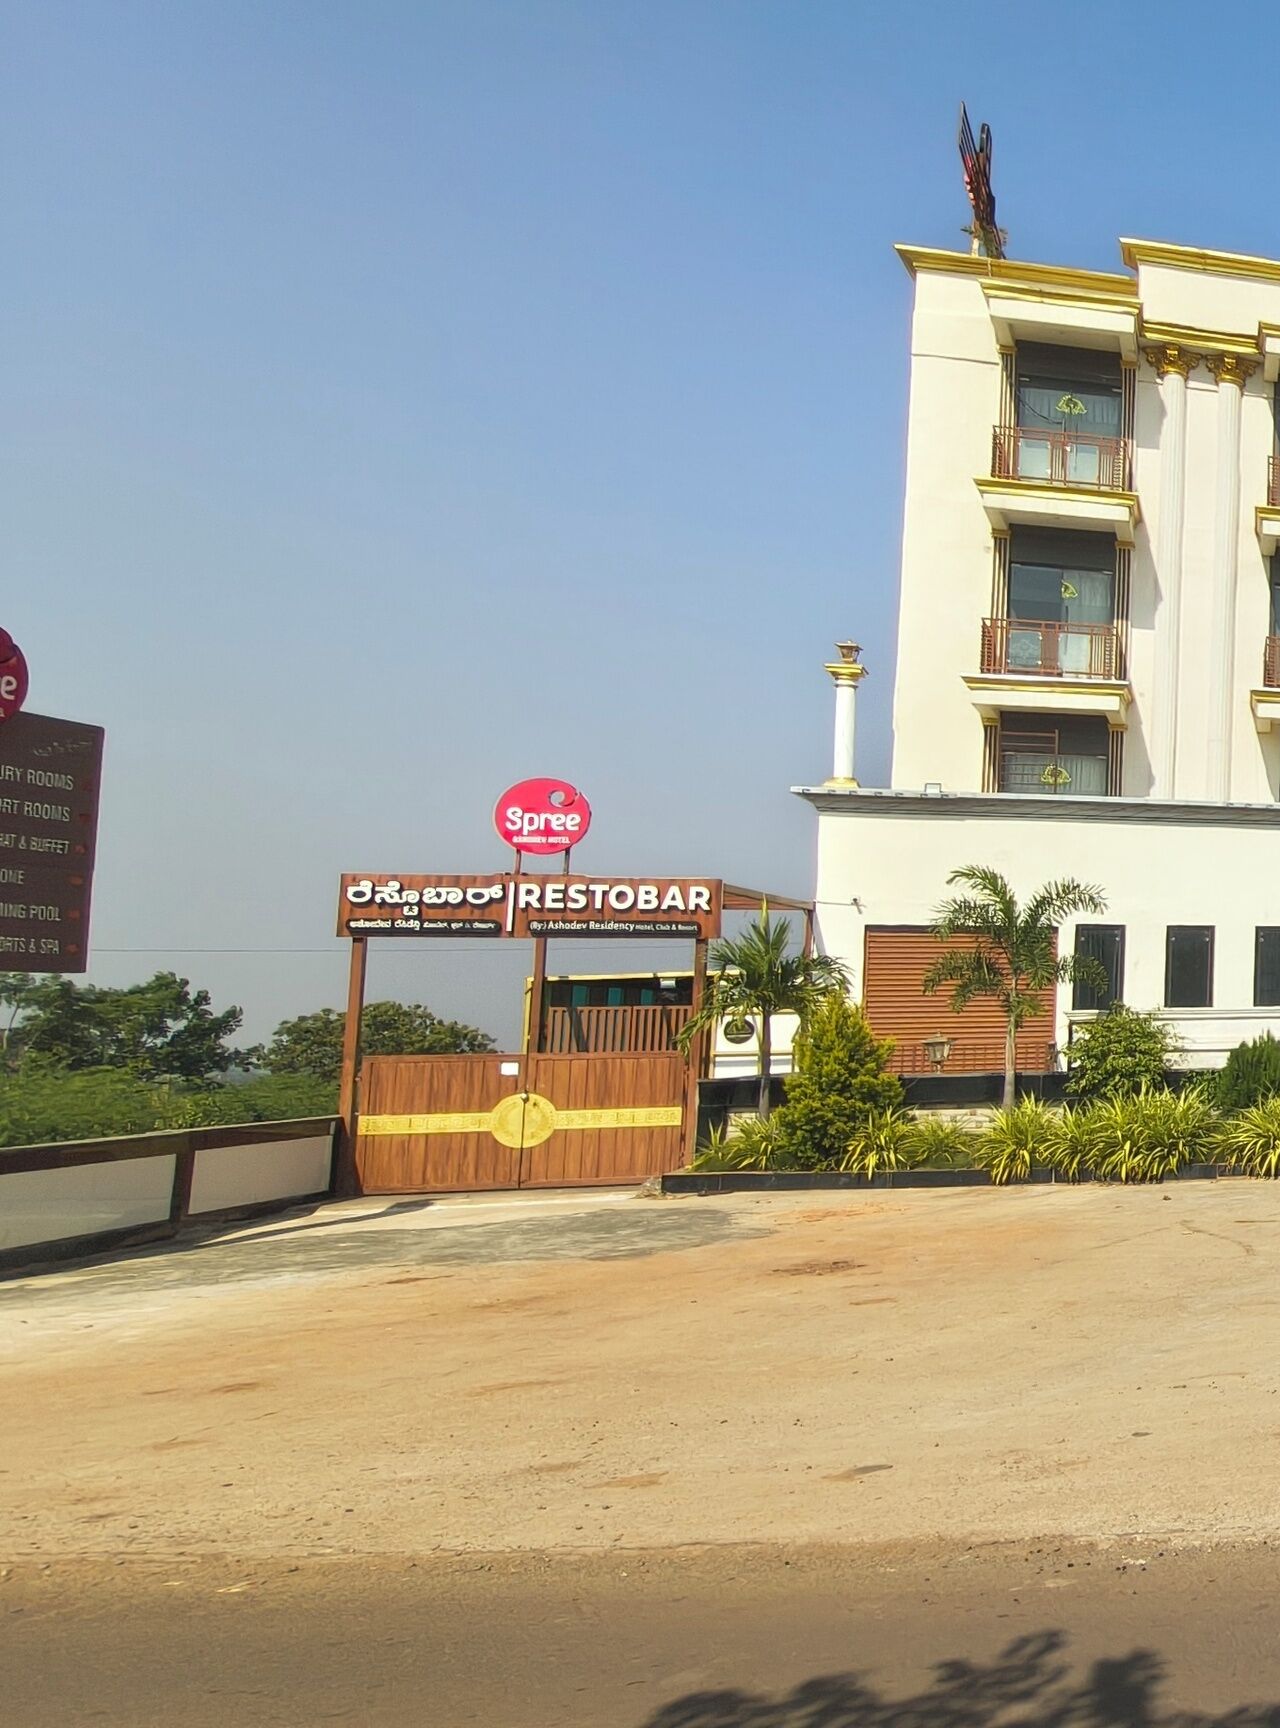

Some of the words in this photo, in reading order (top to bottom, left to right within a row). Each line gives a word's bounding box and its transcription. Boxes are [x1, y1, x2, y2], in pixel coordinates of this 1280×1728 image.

[27, 769, 74, 790] ROOMS
[24, 801, 71, 821] ROOMS
[505, 806, 582, 836] Spree
[19, 836, 27, 849] &
[30, 836, 70, 855] BUFFET
[518, 883, 711, 911] RESTOBAR
[29, 905, 62, 921] POOL
[548, 920, 588, 930] Ashodev
[589, 921, 635, 932] Residency
[40, 939, 60, 955] SPA
